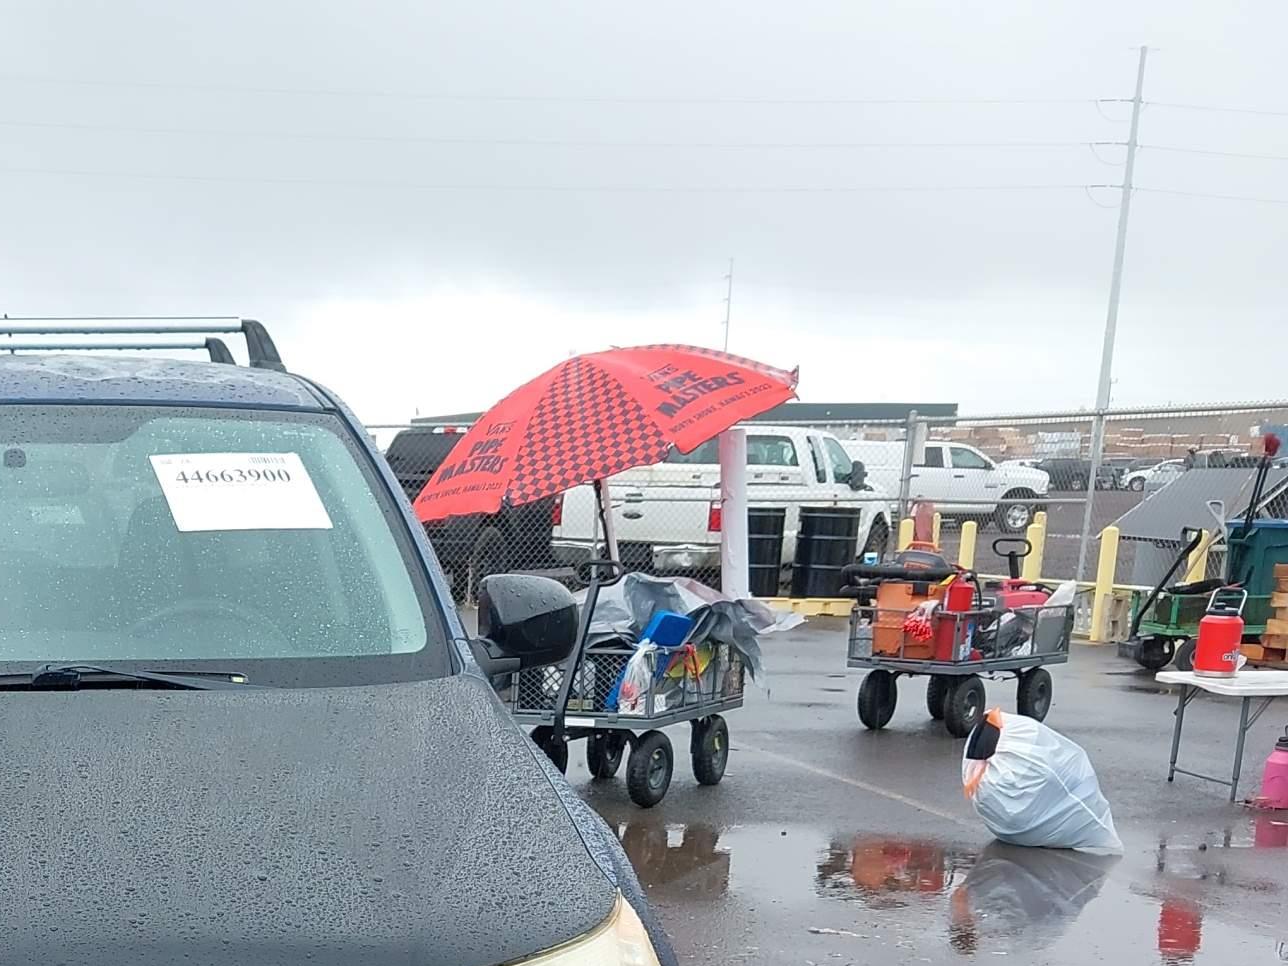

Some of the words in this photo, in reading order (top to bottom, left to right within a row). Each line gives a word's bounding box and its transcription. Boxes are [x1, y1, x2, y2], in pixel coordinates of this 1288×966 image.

[654, 371, 702, 394] PIPE
[656, 372, 745, 418] MASTERS
[468, 437, 507, 457] PIPE
[176, 469, 291, 483] 44663900
[436, 455, 509, 485] MASTERS
